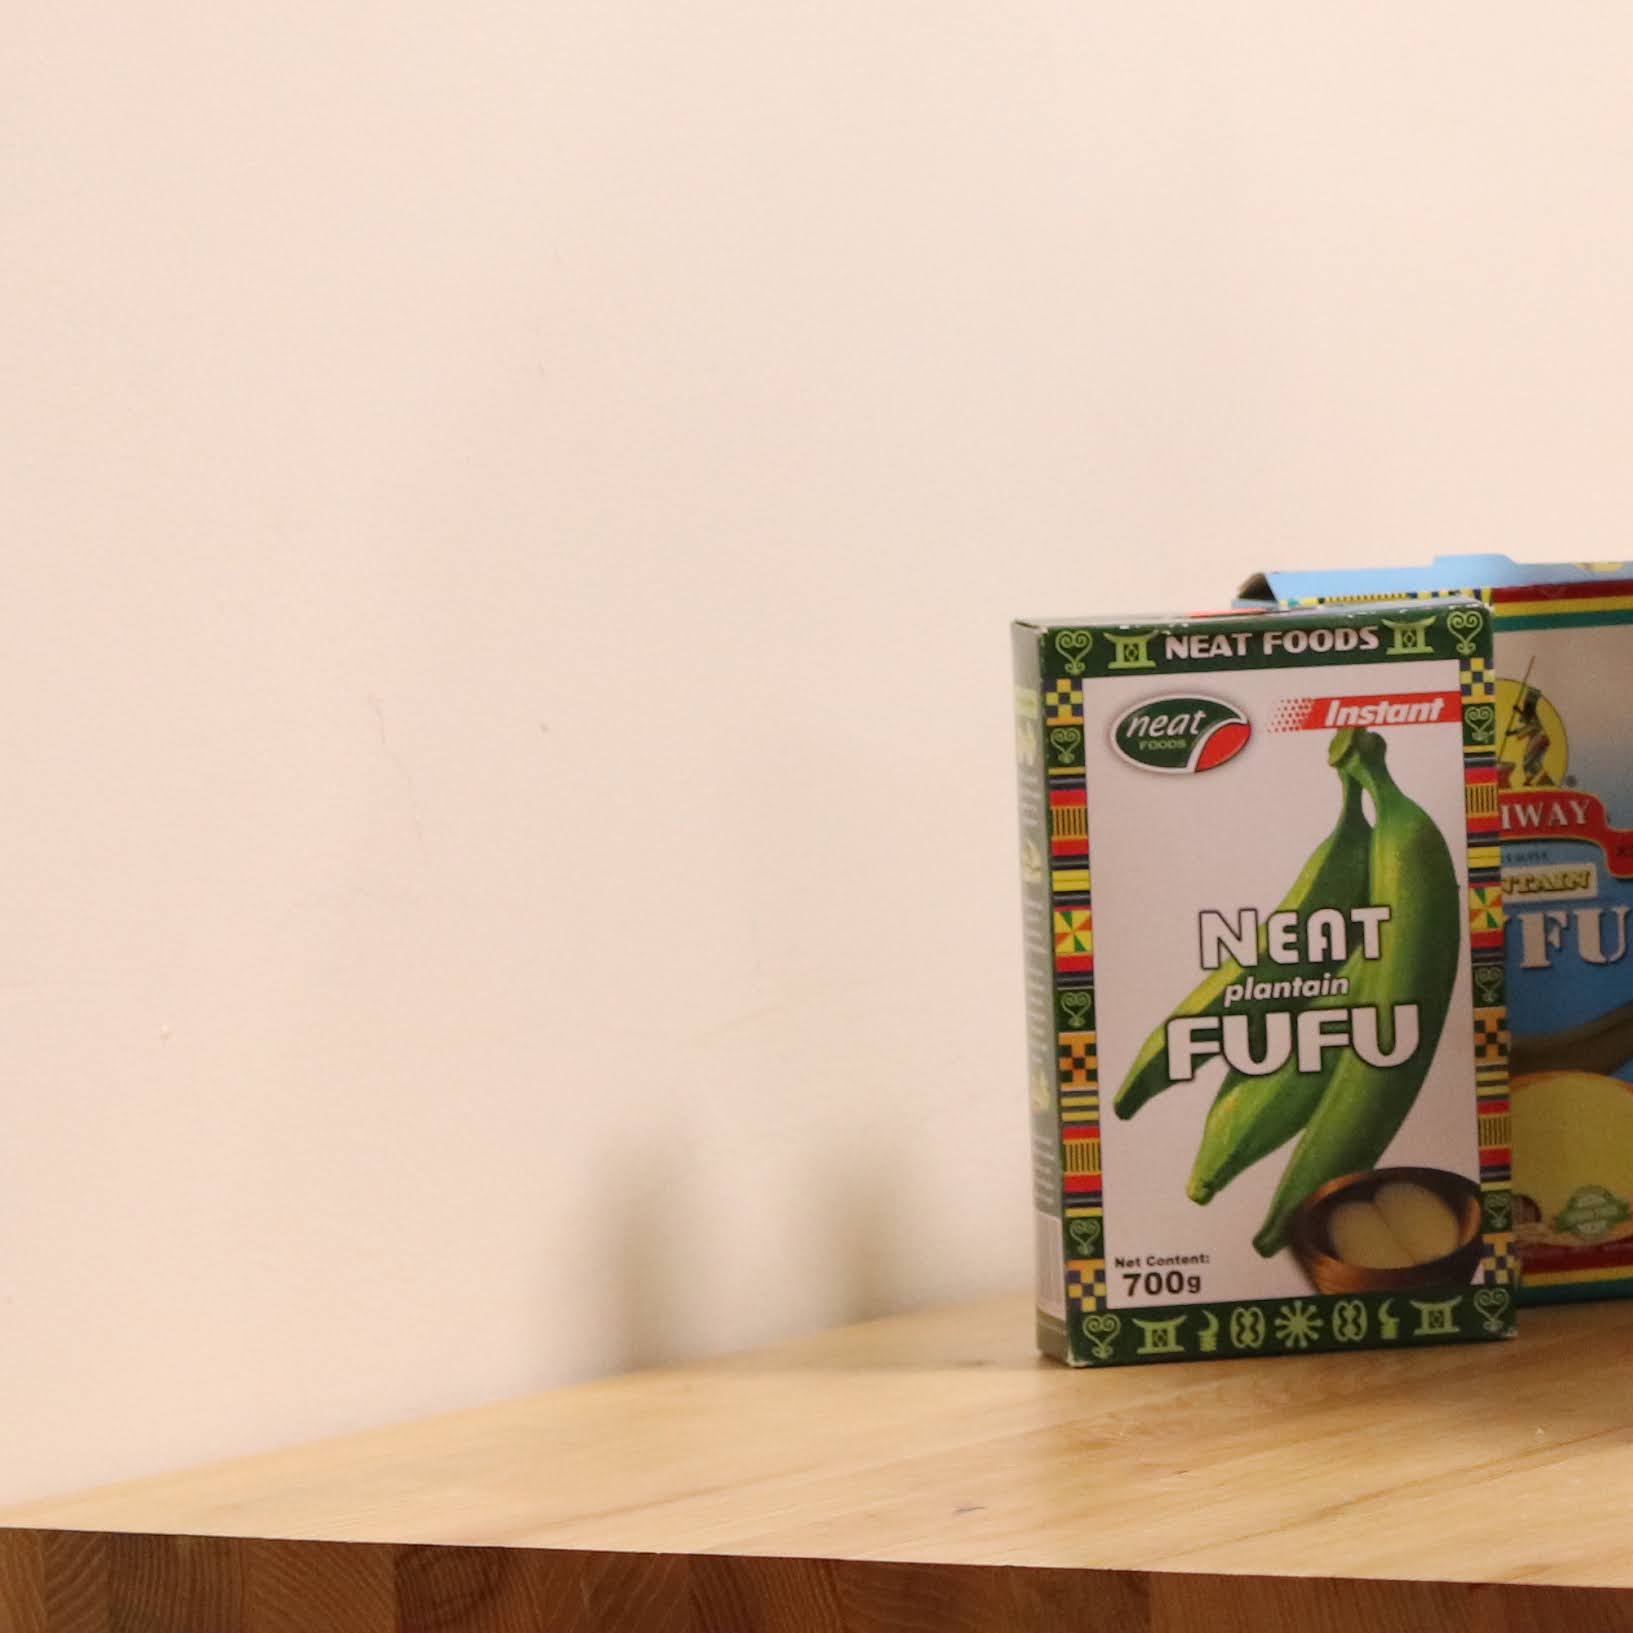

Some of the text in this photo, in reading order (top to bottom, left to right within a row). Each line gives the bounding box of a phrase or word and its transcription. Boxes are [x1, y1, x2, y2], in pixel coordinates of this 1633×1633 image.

[1165, 625, 1380, 660] NEAT FOODS
[1126, 709, 1206, 737] neat
[1323, 697, 1446, 727] Instant
[1500, 799, 1590, 830] IWAY
[1199, 907, 1391, 970] NEAT
[1504, 905, 1631, 968] FU
[1223, 973, 1350, 1008] plantain
[1166, 1003, 1420, 1081] FUFU
[1114, 1253, 1210, 1268] Net Content:
[1122, 1270, 1202, 1297] 700g
